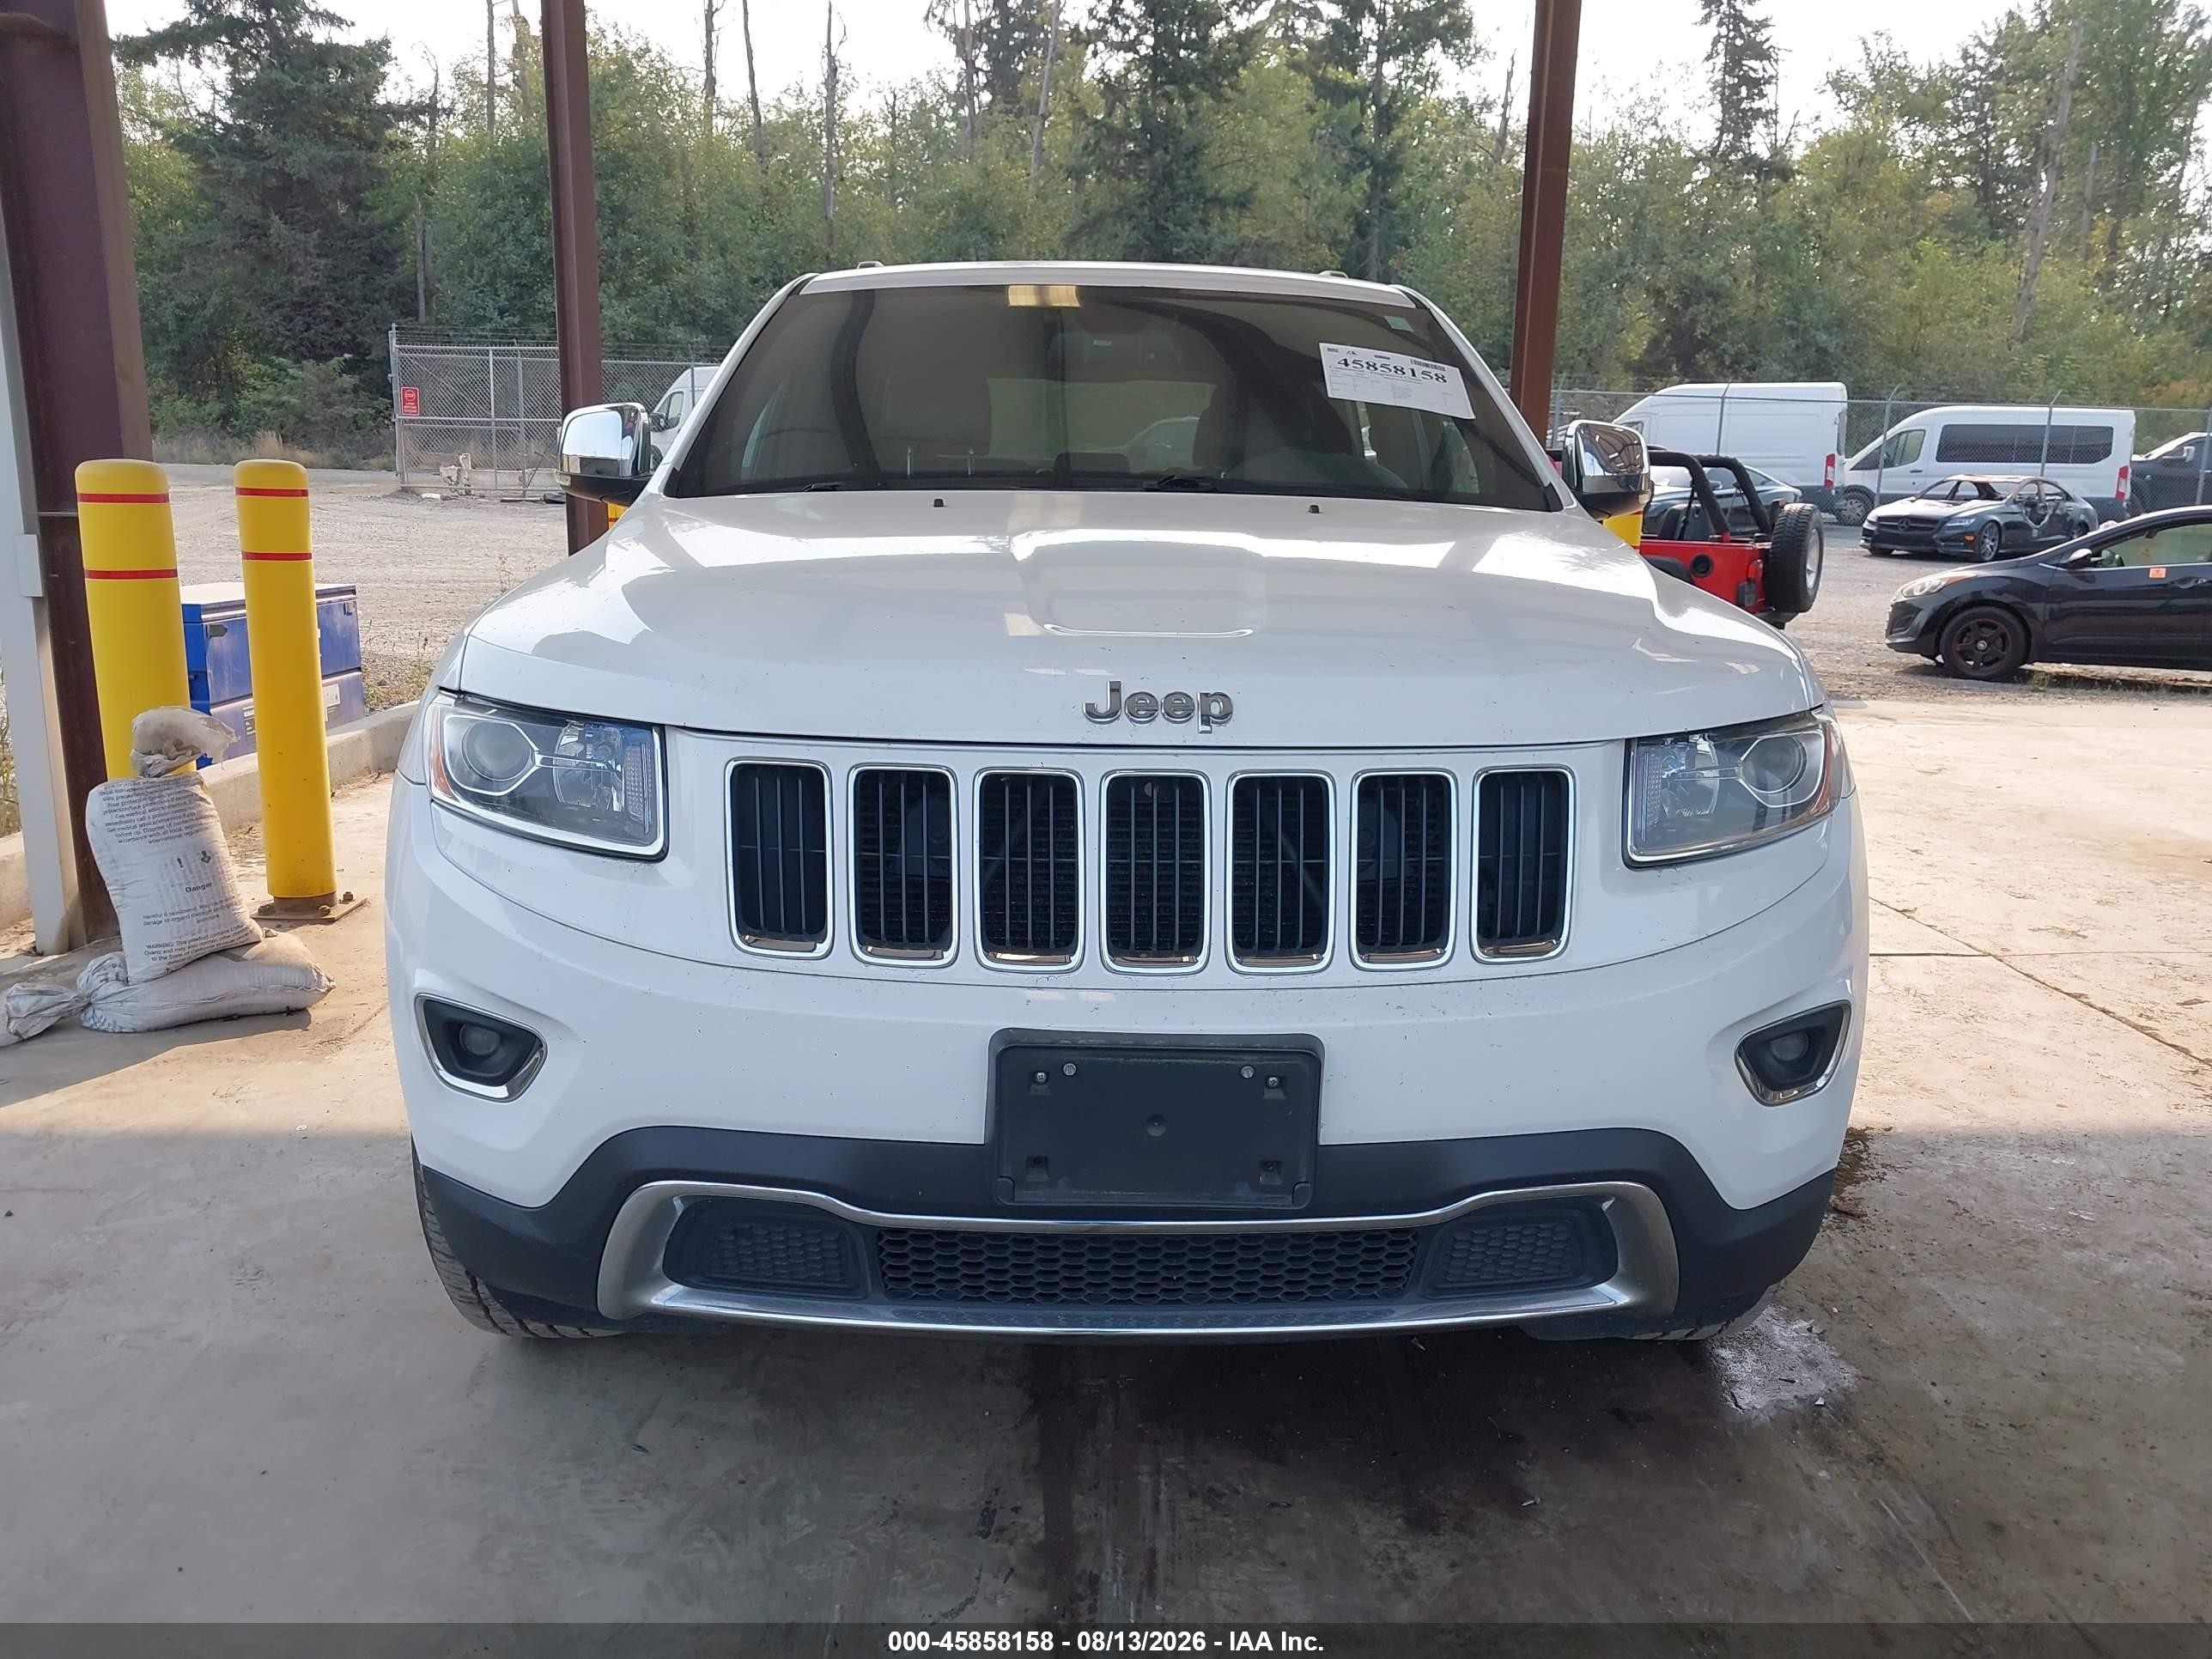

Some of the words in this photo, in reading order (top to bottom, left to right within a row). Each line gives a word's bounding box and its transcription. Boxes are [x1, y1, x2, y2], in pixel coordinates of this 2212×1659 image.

[1337, 358, 1448, 384] 45858158
[1083, 680, 1233, 733] Jeep
[185, 883, 212, 893] Danger
